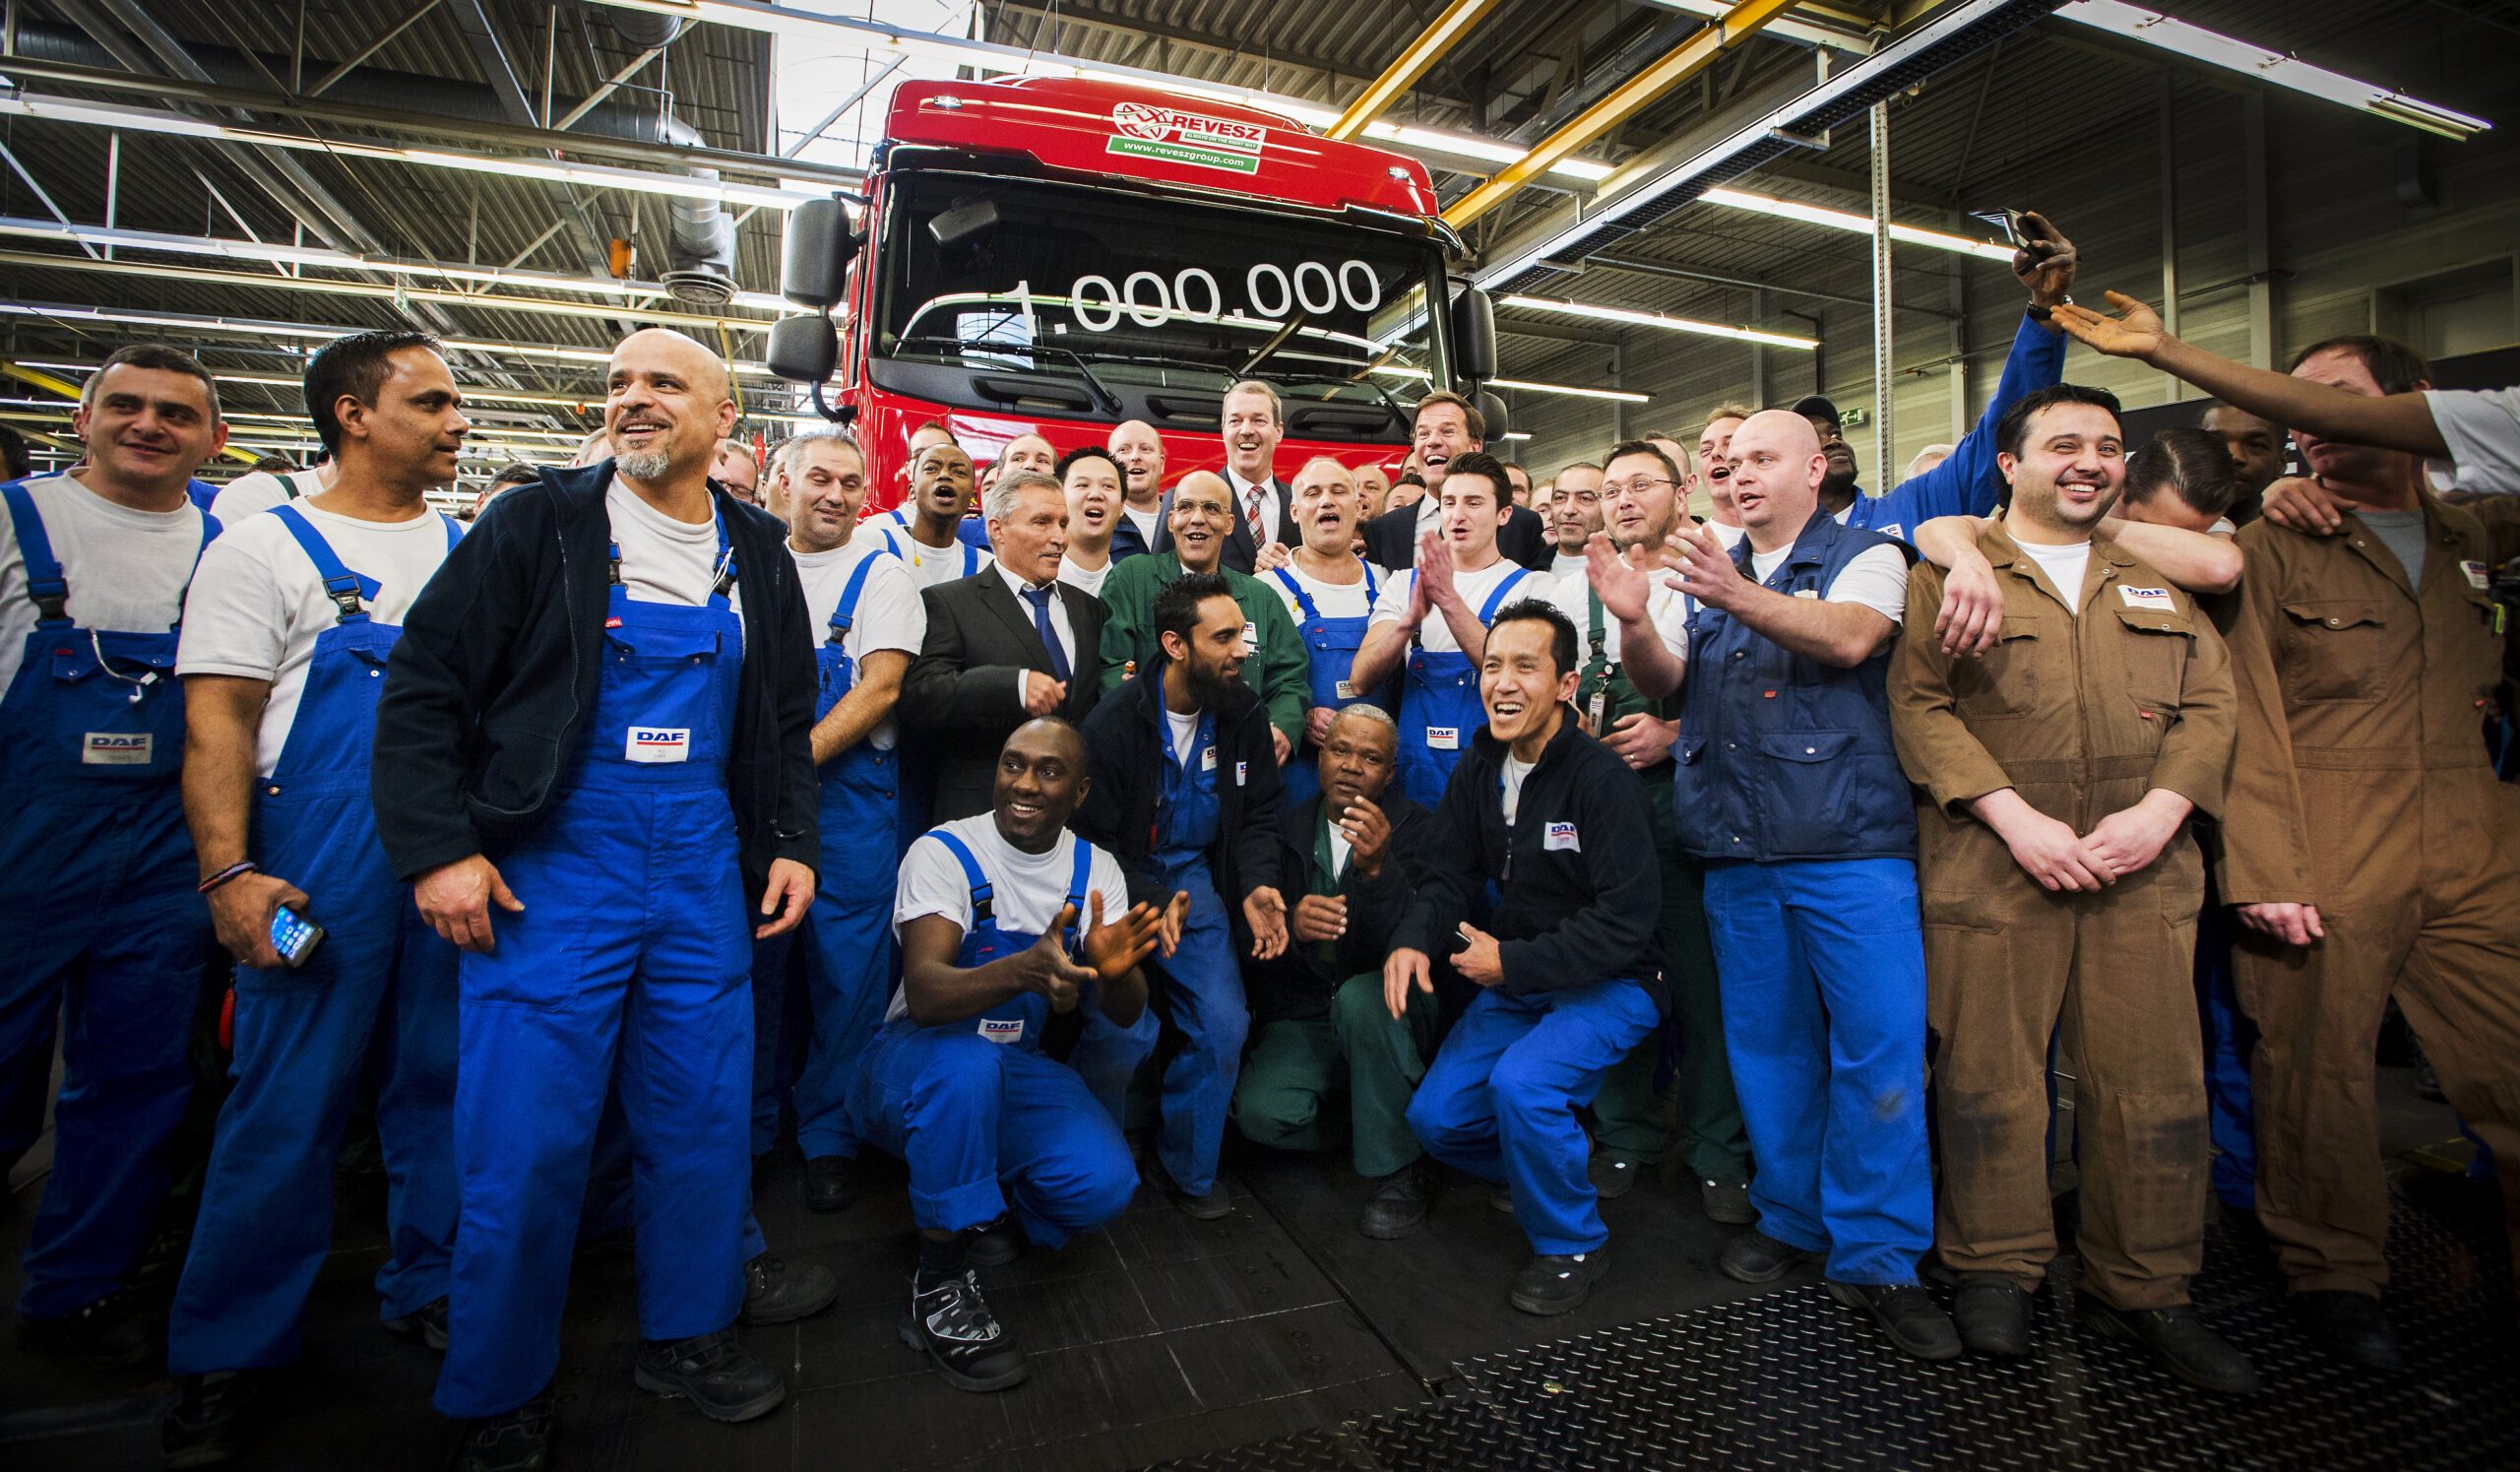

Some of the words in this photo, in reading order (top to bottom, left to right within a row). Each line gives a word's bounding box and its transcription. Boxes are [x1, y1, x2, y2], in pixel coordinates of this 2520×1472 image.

[1171, 115, 1262, 141] REVESZ
[1124, 141, 1244, 166] www.reveszgroup.com
[1003, 260, 1381, 338] 1.000.000
[637, 732, 684, 741] DAF
